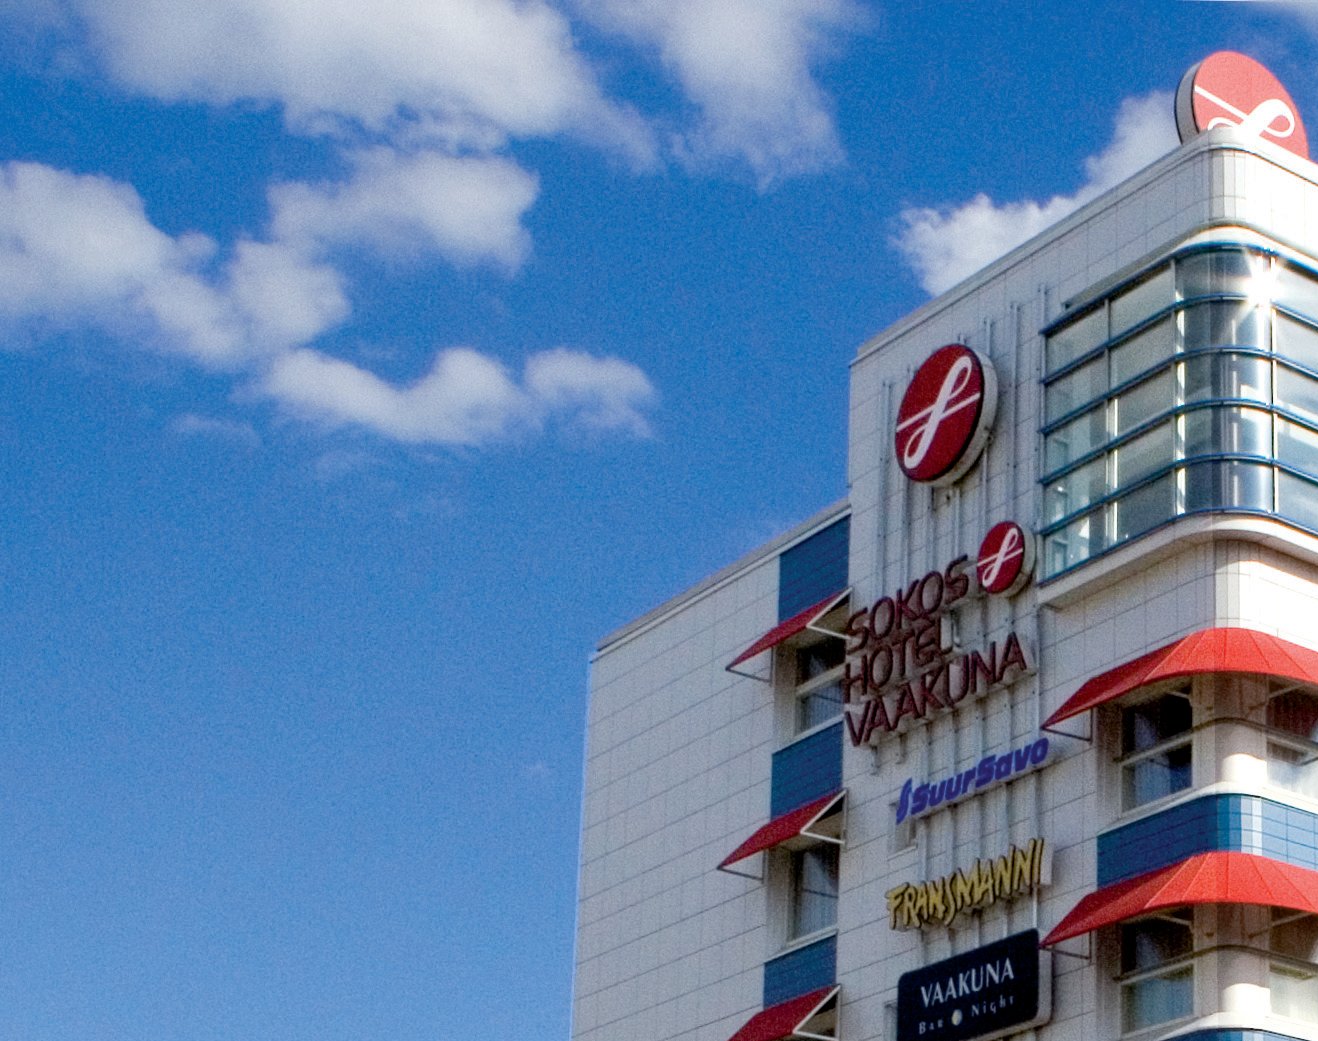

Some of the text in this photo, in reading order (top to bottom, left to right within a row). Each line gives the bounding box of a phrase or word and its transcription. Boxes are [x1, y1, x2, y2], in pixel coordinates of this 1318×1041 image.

[845, 554, 969, 656] SOKOS
[843, 613, 954, 704] HOTEL
[844, 632, 1028, 747] VAAKUNA
[886, 838, 1045, 930] FRANSMANNI
[921, 957, 1015, 1008] VAAKUNA
